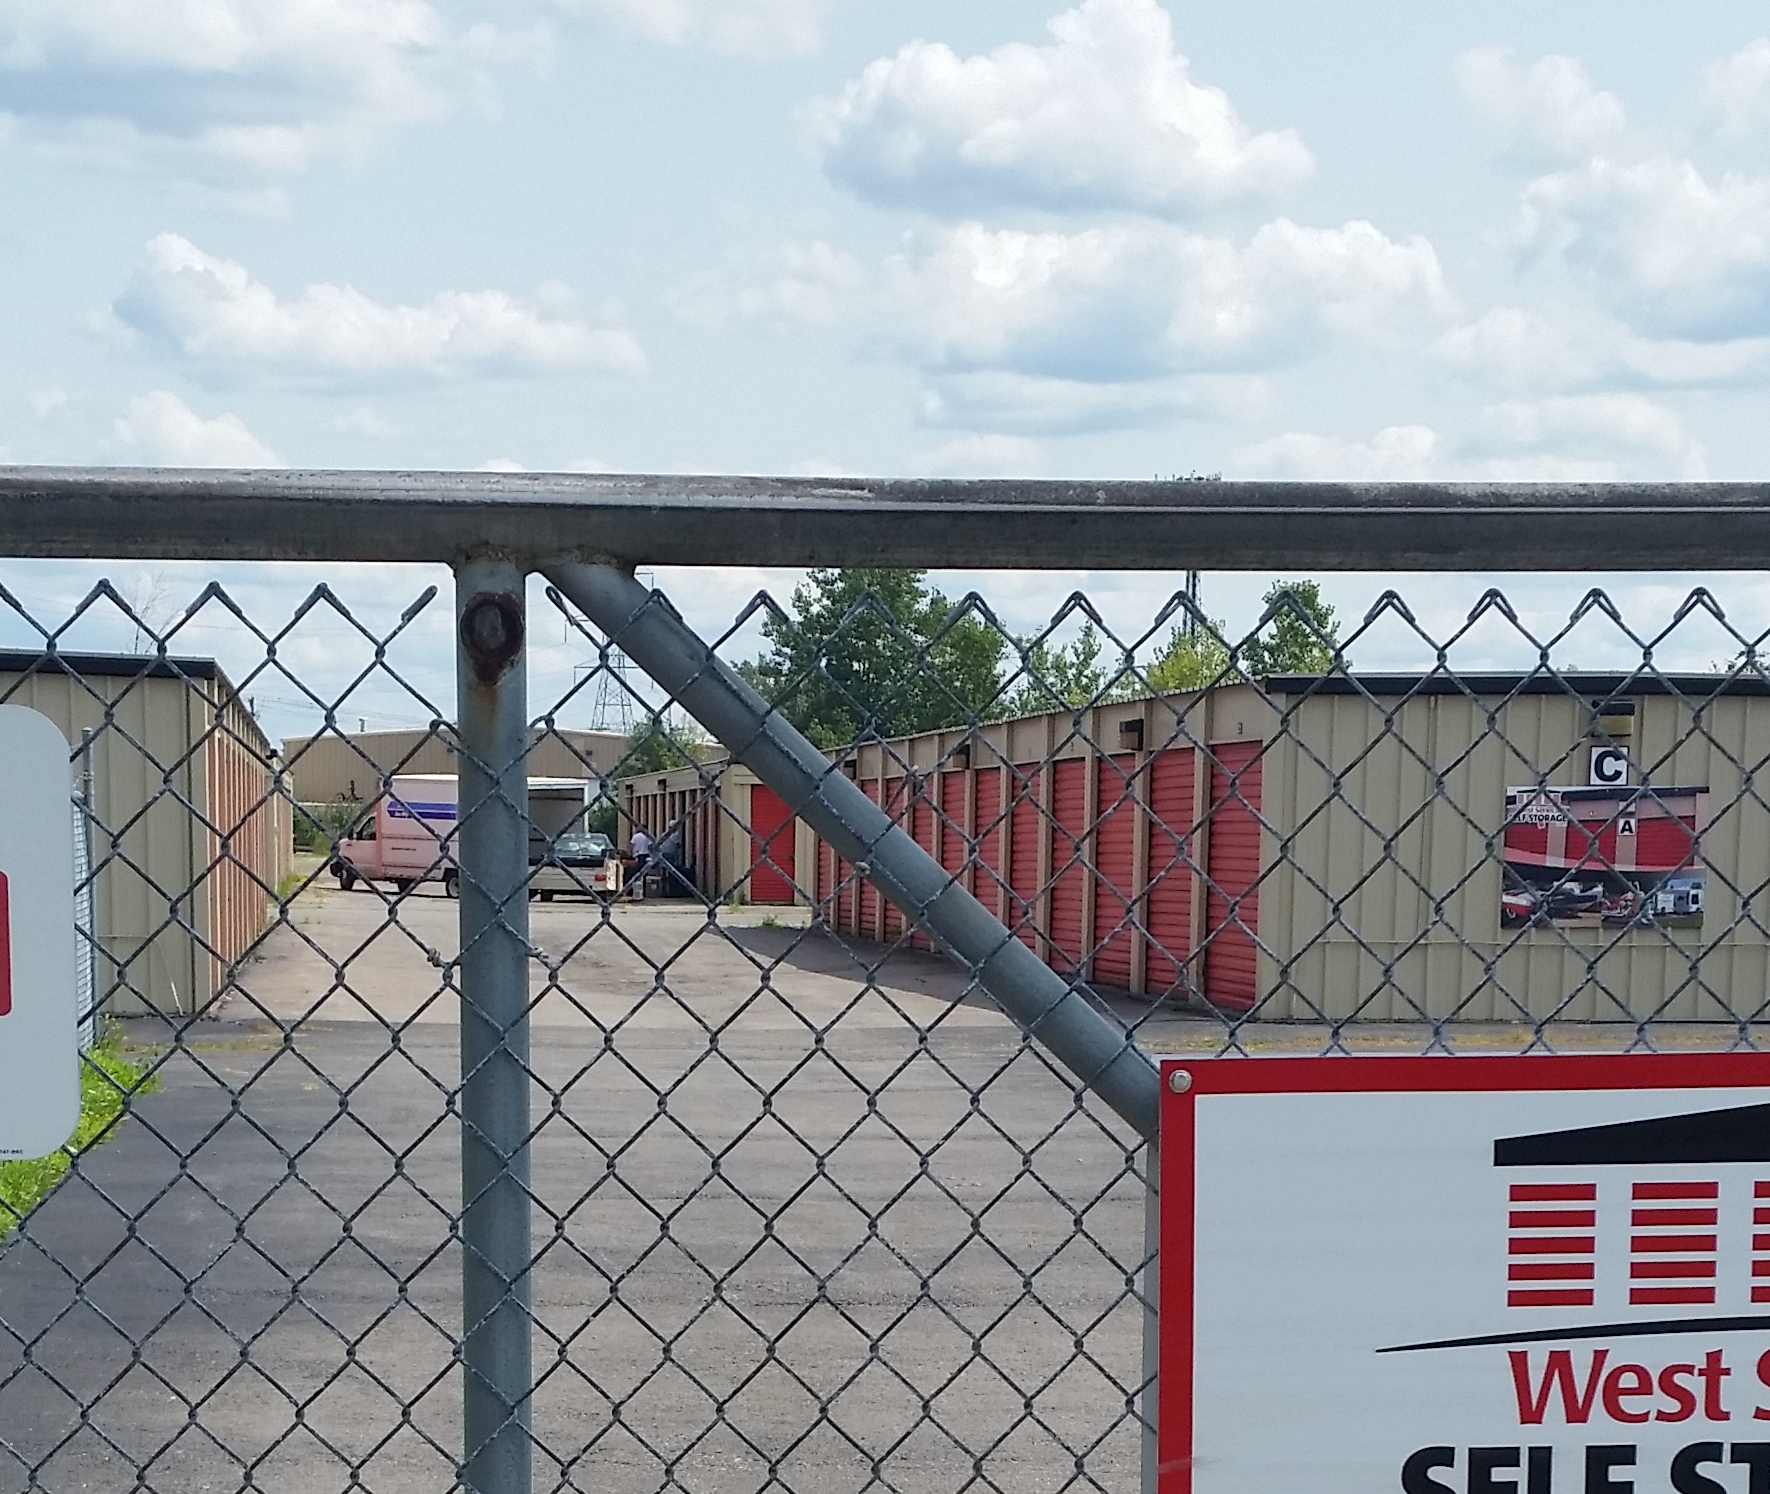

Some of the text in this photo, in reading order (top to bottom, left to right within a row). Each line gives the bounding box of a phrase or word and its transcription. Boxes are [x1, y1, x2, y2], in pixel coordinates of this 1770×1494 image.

[1594, 750, 1623, 782] C
[1620, 820, 1634, 834] A
[1509, 1347, 1731, 1425] West
